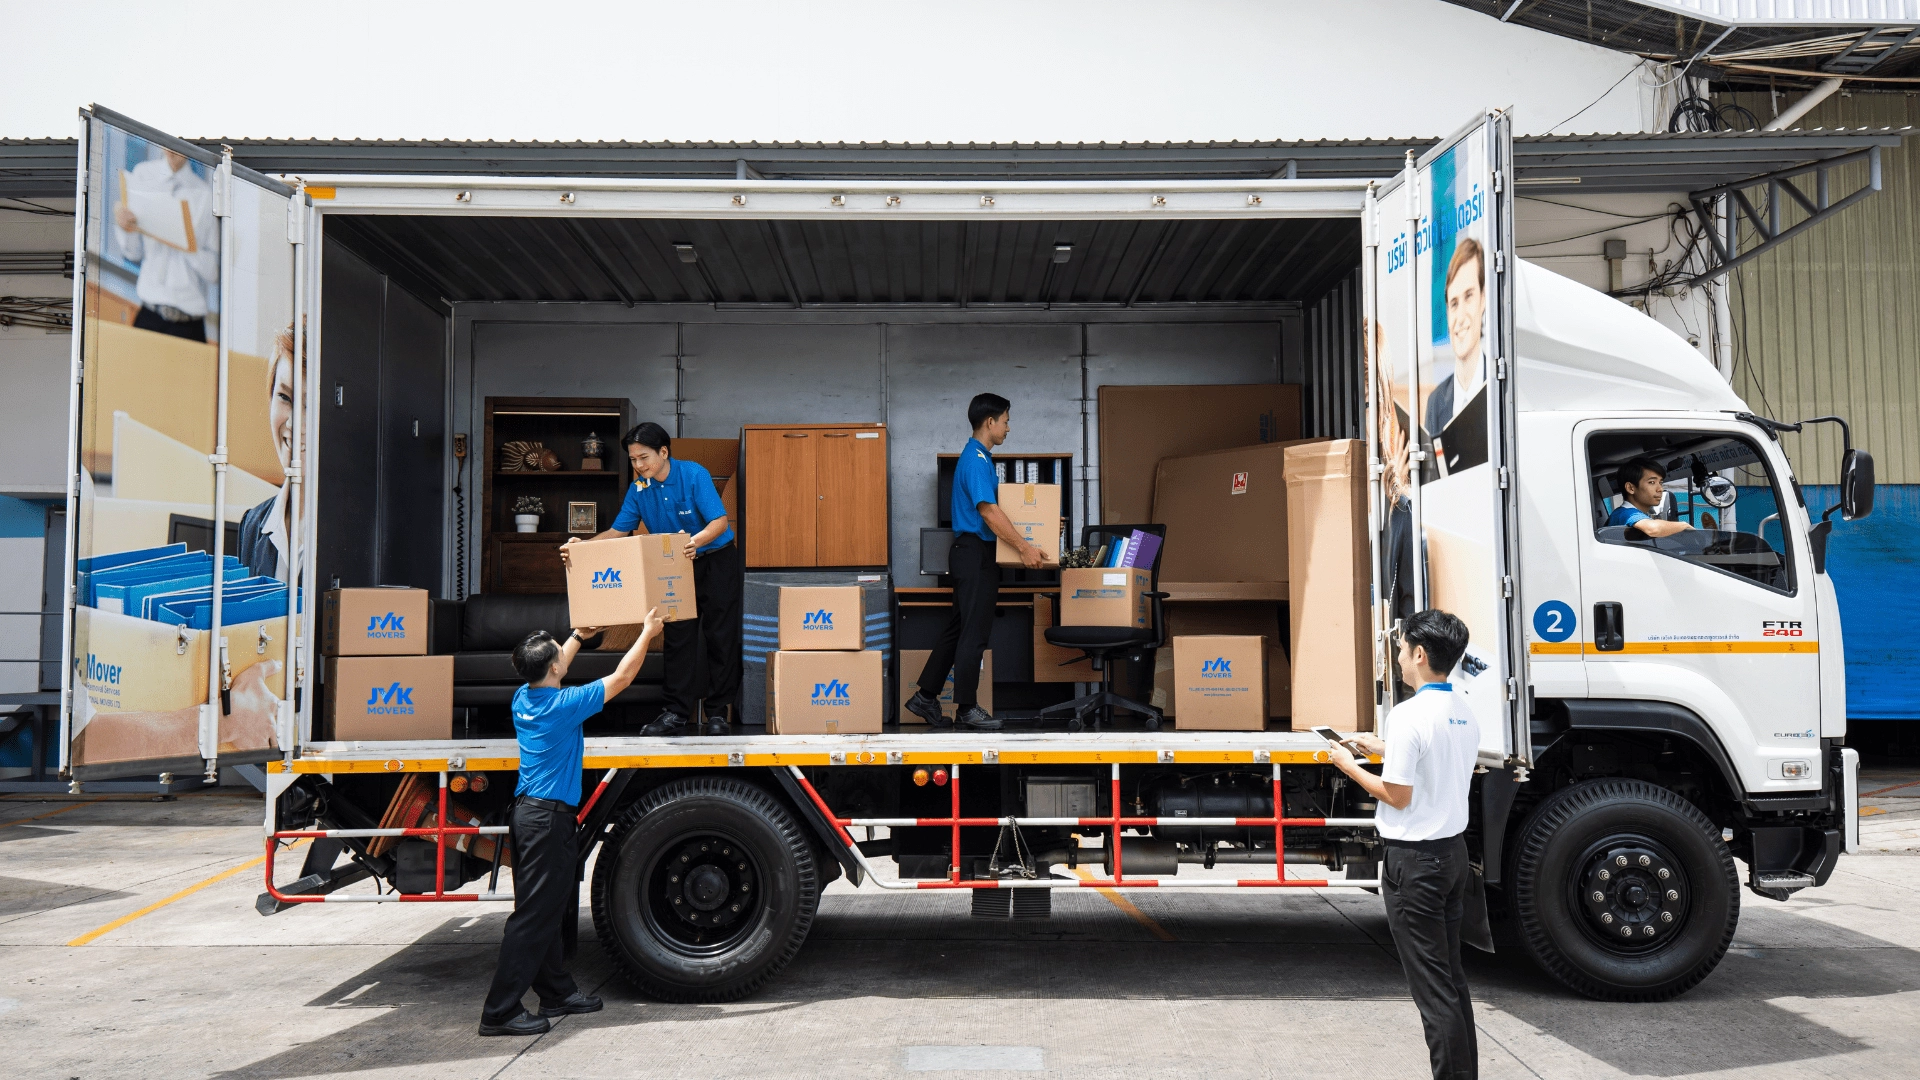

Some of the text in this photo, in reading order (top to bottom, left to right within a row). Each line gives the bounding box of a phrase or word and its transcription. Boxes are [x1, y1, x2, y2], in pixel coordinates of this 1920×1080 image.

[592, 567, 622, 583] JVK
[367, 612, 405, 631] JVK
[803, 609, 833, 624] JVK
[1546, 609, 1564, 633] 2
[1762, 620, 1802, 629] FTR
[1763, 629, 1803, 637] 240
[87, 653, 122, 685] Mover
[1201, 657, 1232, 672] JVK
[367, 682, 414, 705] JVK
[811, 679, 850, 698] JVK
[367, 706, 415, 714] MOVERS
